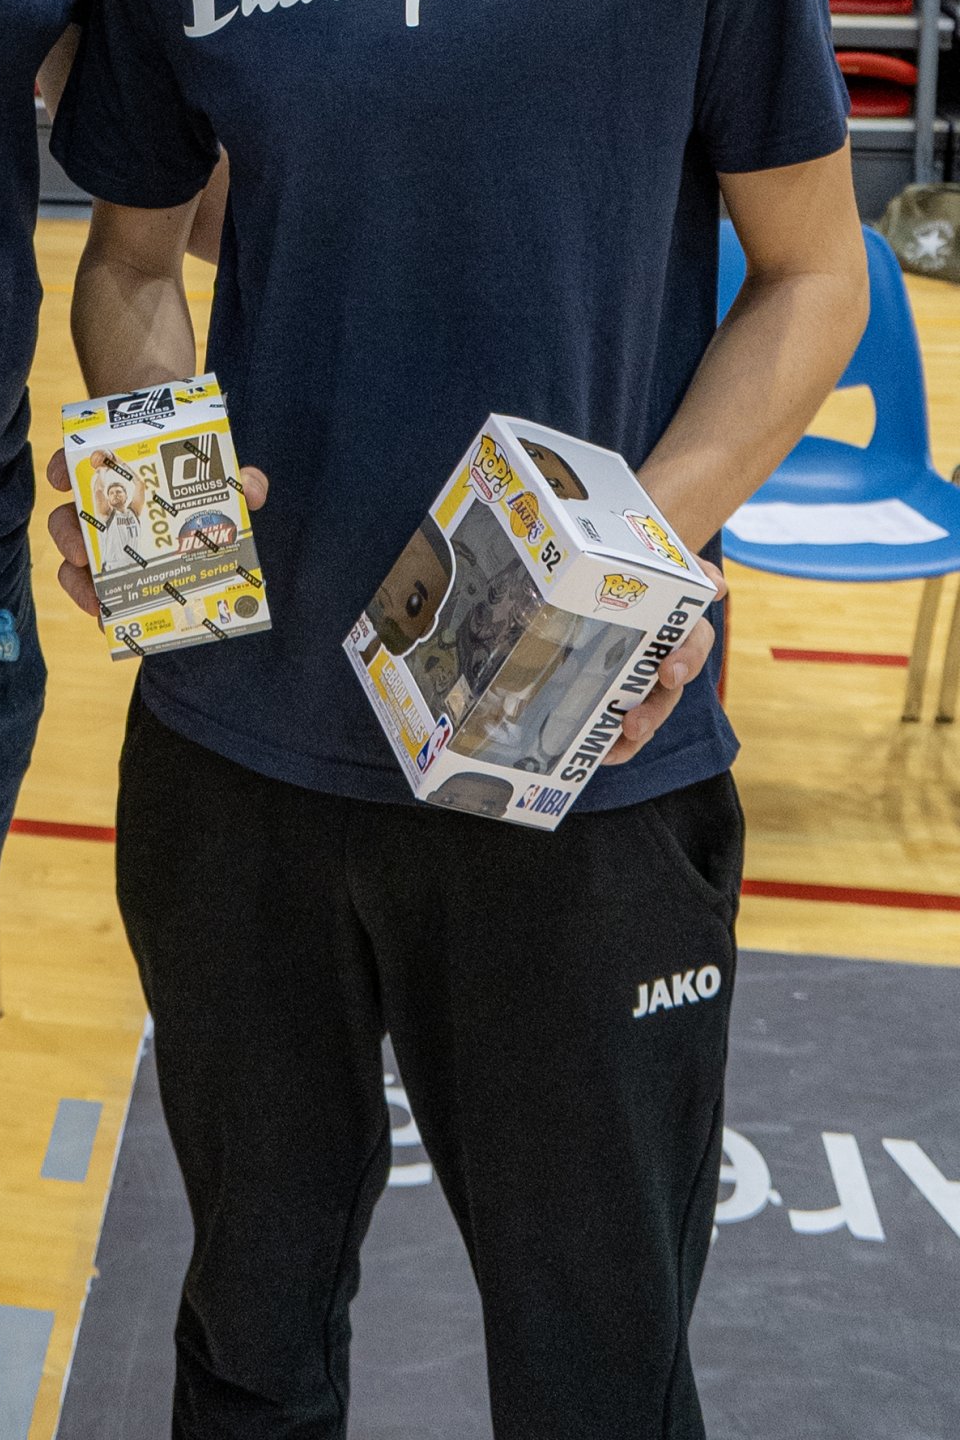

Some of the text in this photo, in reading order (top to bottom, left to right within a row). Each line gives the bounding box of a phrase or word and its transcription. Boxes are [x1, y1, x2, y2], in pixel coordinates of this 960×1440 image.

[473, 434, 513, 494] POP!
[172, 479, 224, 498] DONRUSS
[174, 492, 230, 510] BASKETBALL
[507, 492, 542, 545] LAKERS
[541, 540, 561, 573] 52
[104, 564, 192, 596] Look for Autographs
[128, 590, 139, 602] in
[200, 559, 238, 580] Series!
[600, 573, 649, 602] POP!
[114, 622, 142, 641] 88
[381, 661, 409, 705] LeBRON
[403, 701, 429, 744] JAMES
[560, 595, 705, 783] LeBRON JAMES
[530, 786, 572, 817] NBA
[632, 964, 722, 1018] JAKO
